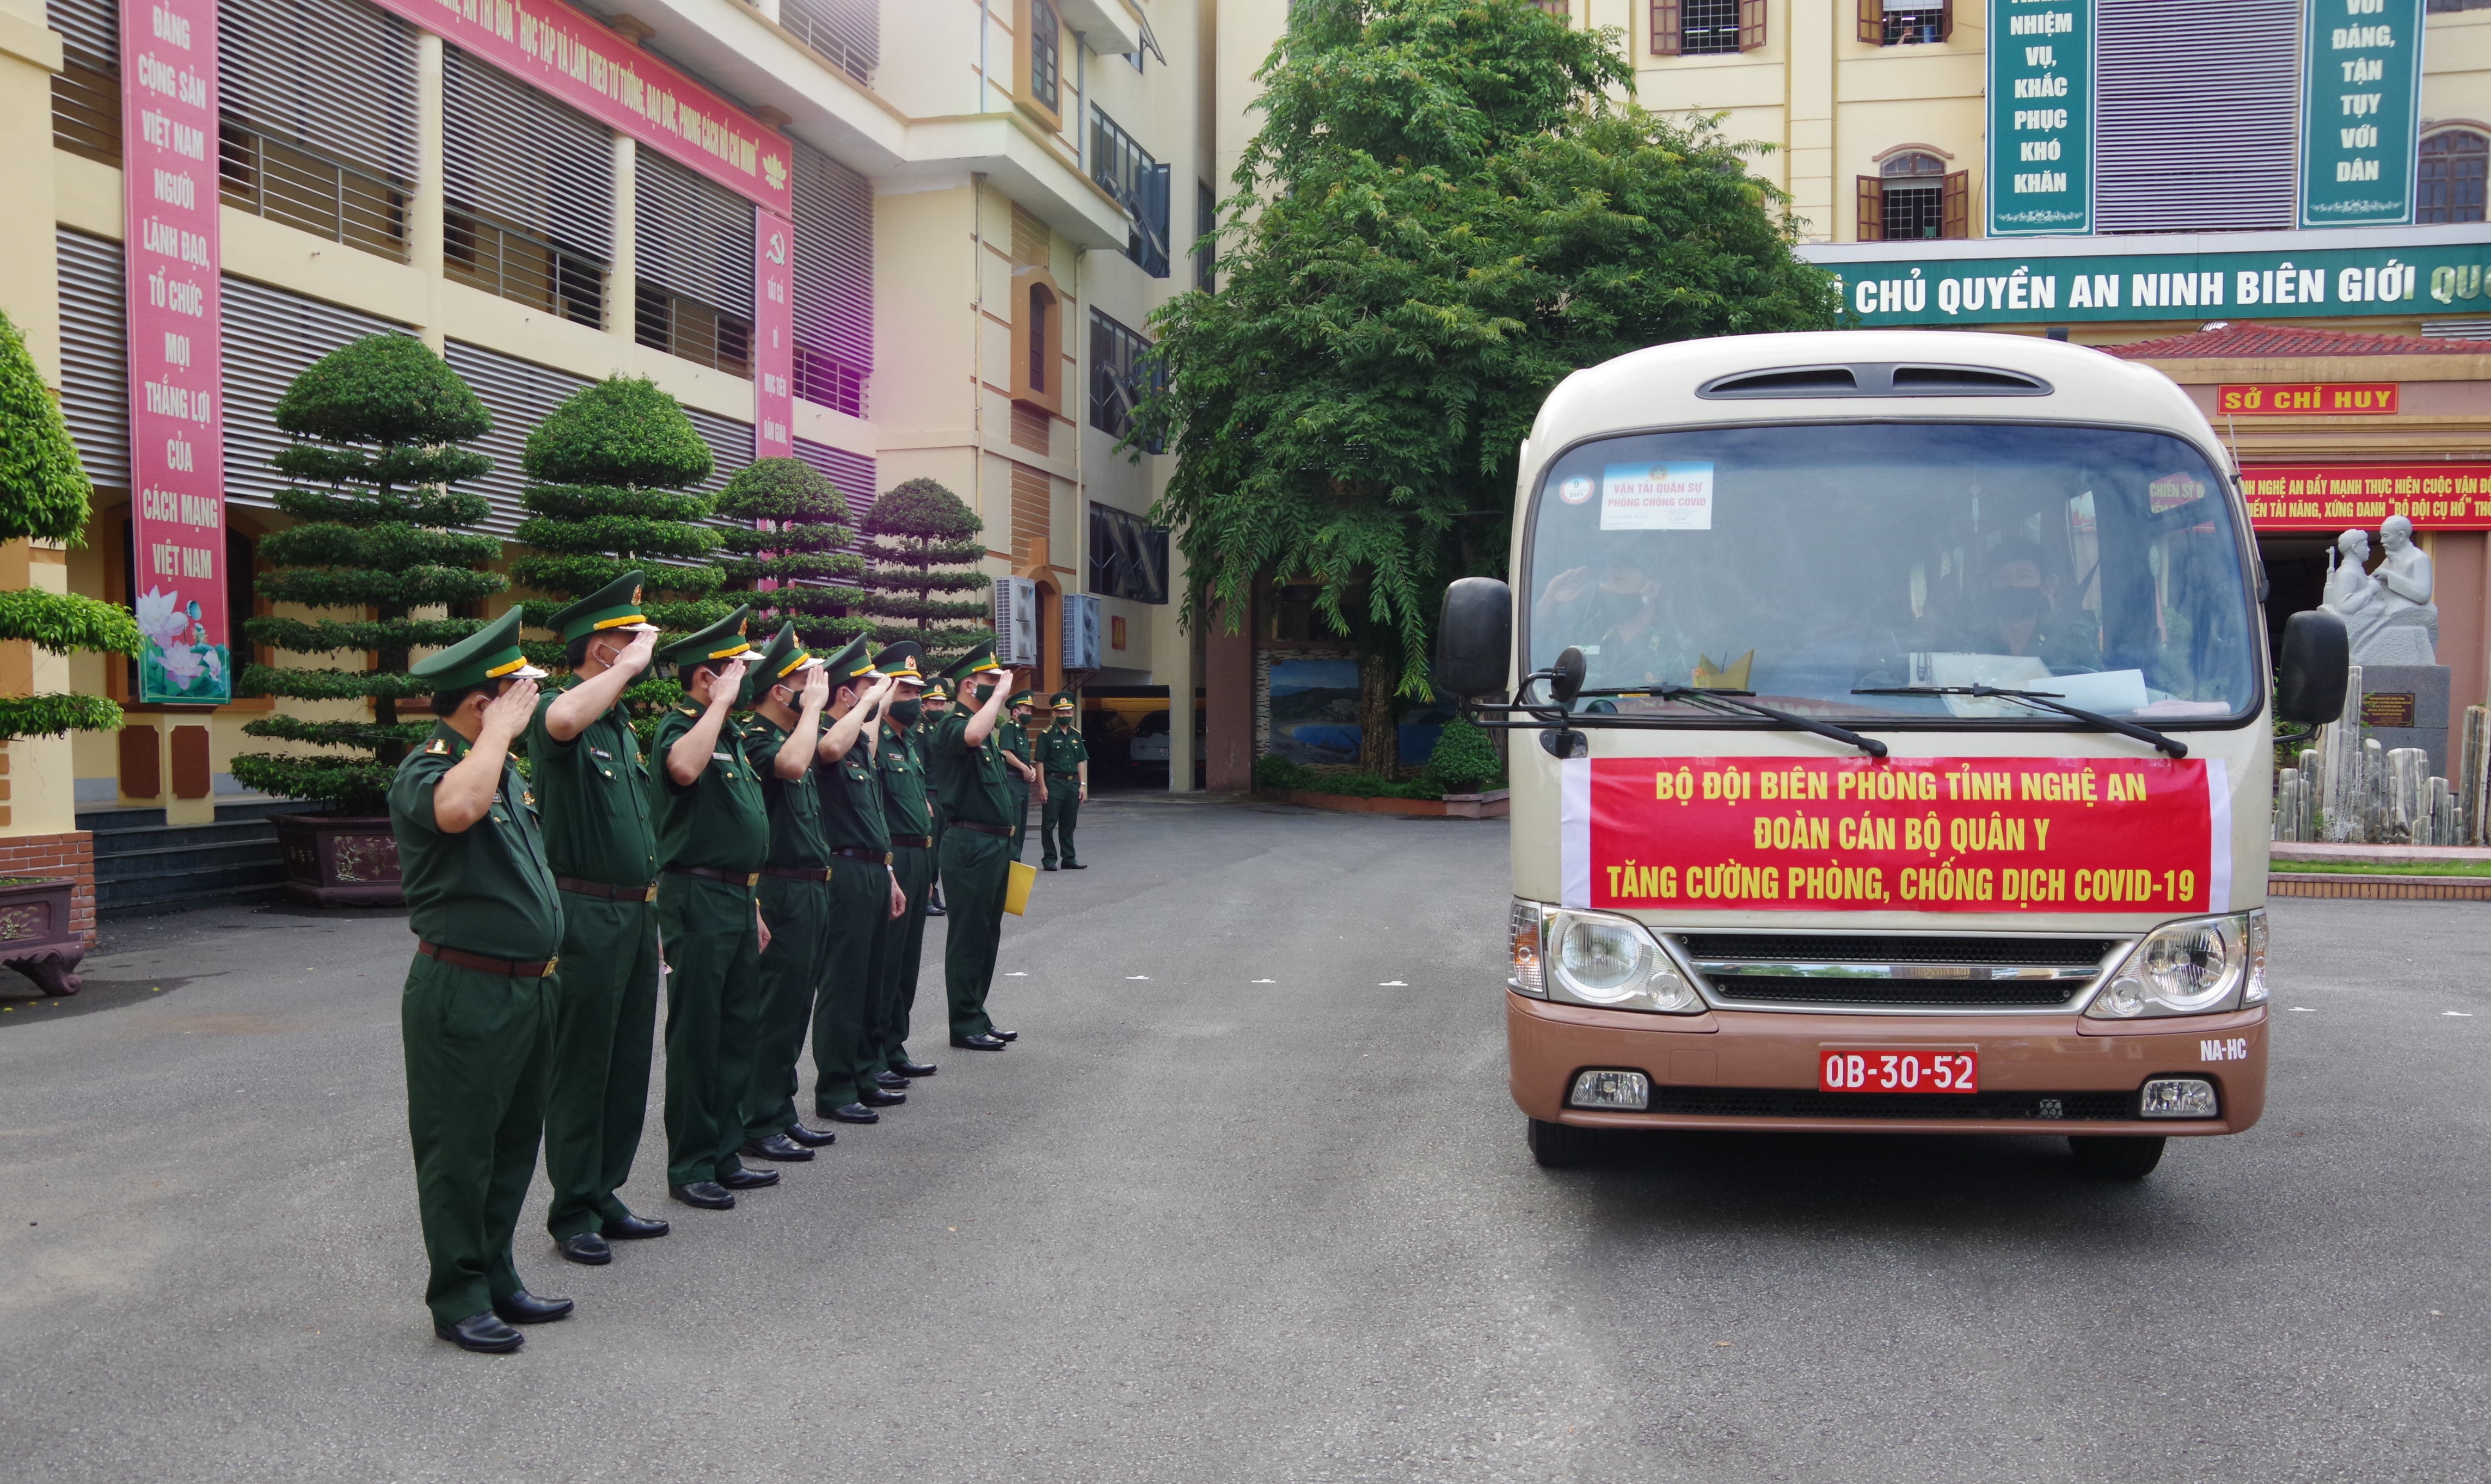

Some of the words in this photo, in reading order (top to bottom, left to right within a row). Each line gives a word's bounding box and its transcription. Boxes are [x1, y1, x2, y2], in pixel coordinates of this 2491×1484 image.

[153, 0, 190, 51] ĐẢNG
[2010, 10, 2072, 37] NHIỆM
[2332, 22, 2396, 50] ĐẢNG,
[2025, 46, 2057, 69] VỤ,
[2341, 57, 2383, 85] TẬN
[139, 52, 176, 97] CỘNG
[179, 65, 206, 110] SẢN
[539, 16, 555, 72] TẬP
[557, 27, 568, 73] VÀ
[570, 33, 586, 83] LÀM
[588, 49, 608, 95] THEO
[609, 61, 619, 101] TƯ
[679, 102, 701, 146] PHONG
[702, 112, 719, 157] CÁCH
[2015, 72, 2067, 98] KHẮC
[2015, 109, 2067, 132] PHỤC
[2341, 93, 2382, 118] TỤY
[142, 109, 170, 153] VIỆT
[174, 122, 204, 161] NAM
[2021, 138, 2060, 161] KHÓ
[2341, 124, 2377, 148] VỚI
[2015, 170, 2066, 193] KHĂN
[2336, 157, 2379, 182] DÂN
[154, 168, 194, 211] NGƯỜI
[143, 215, 178, 257] LÃNH
[181, 231, 210, 271] ĐẠO,
[149, 266, 165, 307] TỔ
[169, 279, 203, 317] CHỨC
[1856, 268, 1925, 313] CHỦ
[1938, 266, 2055, 315] QUYỀN
[2069, 274, 2119, 307] AN
[2132, 272, 2223, 306] NINH
[2237, 262, 2324, 304] BIÊN
[2338, 259, 2415, 302] GIỚI
[2431, 261, 2491, 304] QU
[165, 332, 189, 372] MỌI
[145, 373, 188, 418] THẮNG
[192, 391, 210, 429] LỢI
[2225, 387, 2262, 409] SỞ
[2274, 386, 2321, 408] CHỈ
[2335, 391, 2391, 408] HUY
[167, 430, 193, 472] CỦA
[1608, 494, 1640, 507] PHÒNG
[1643, 495, 1675, 507] CHỐNG
[1679, 497, 1706, 506] COVID
[1614, 482, 1633, 495] VẬN
[1637, 480, 1653, 493] TẢI
[1656, 482, 1684, 494] QUÂN
[1688, 482, 1703, 494] SỰ
[2258, 477, 2286, 498] NGHỆ
[2288, 479, 2304, 495] AN
[2306, 473, 2327, 495] ĐẨY
[2330, 479, 2362, 498] MẠNH
[2365, 477, 2392, 497] THỰC
[2395, 476, 2420, 497] HIỆN
[2423, 475, 2452, 497] CUỘC
[2455, 475, 2477, 497] VẬN
[143, 483, 177, 522] CÁCH
[181, 494, 218, 532] MẠNG
[2270, 499, 2286, 517] TÀI
[2289, 500, 2322, 519] NĂNG,
[2324, 499, 2353, 517] XỨNG
[2357, 502, 2385, 516] DANH
[2412, 498, 2430, 520] ĐỘI
[2433, 501, 2447, 520] CỤ
[152, 539, 180, 582] VIỆT
[183, 547, 212, 579] NAM
[1656, 766, 1693, 805] BỘ
[1702, 766, 1750, 805] ĐỘI
[1761, 766, 1827, 799] BIÊN
[1838, 766, 1936, 800] PHÒNG
[1945, 763, 2011, 800] TỈNH
[2022, 767, 2096, 807] NGHỆ
[2107, 773, 2146, 801] AN
[1754, 810, 1829, 849] ĐOÀN
[1839, 811, 1895, 849] CÁN
[1906, 811, 1941, 857] BỘ
[1950, 811, 2024, 854] QUÂN
[2034, 818, 2050, 851] Y
[1607, 859, 1677, 897] TĂNG
[1686, 859, 1778, 898] CƯỜNG
[1788, 859, 1889, 903] PHÒNG,
[1900, 857, 1993, 900] CHỐNG
[2003, 869, 2065, 908] DỊCH
[2075, 869, 2195, 901] COVID-19
[2200, 1037, 2246, 1061] NA-HC
[1826, 1055, 1973, 1088] QB-30-52
